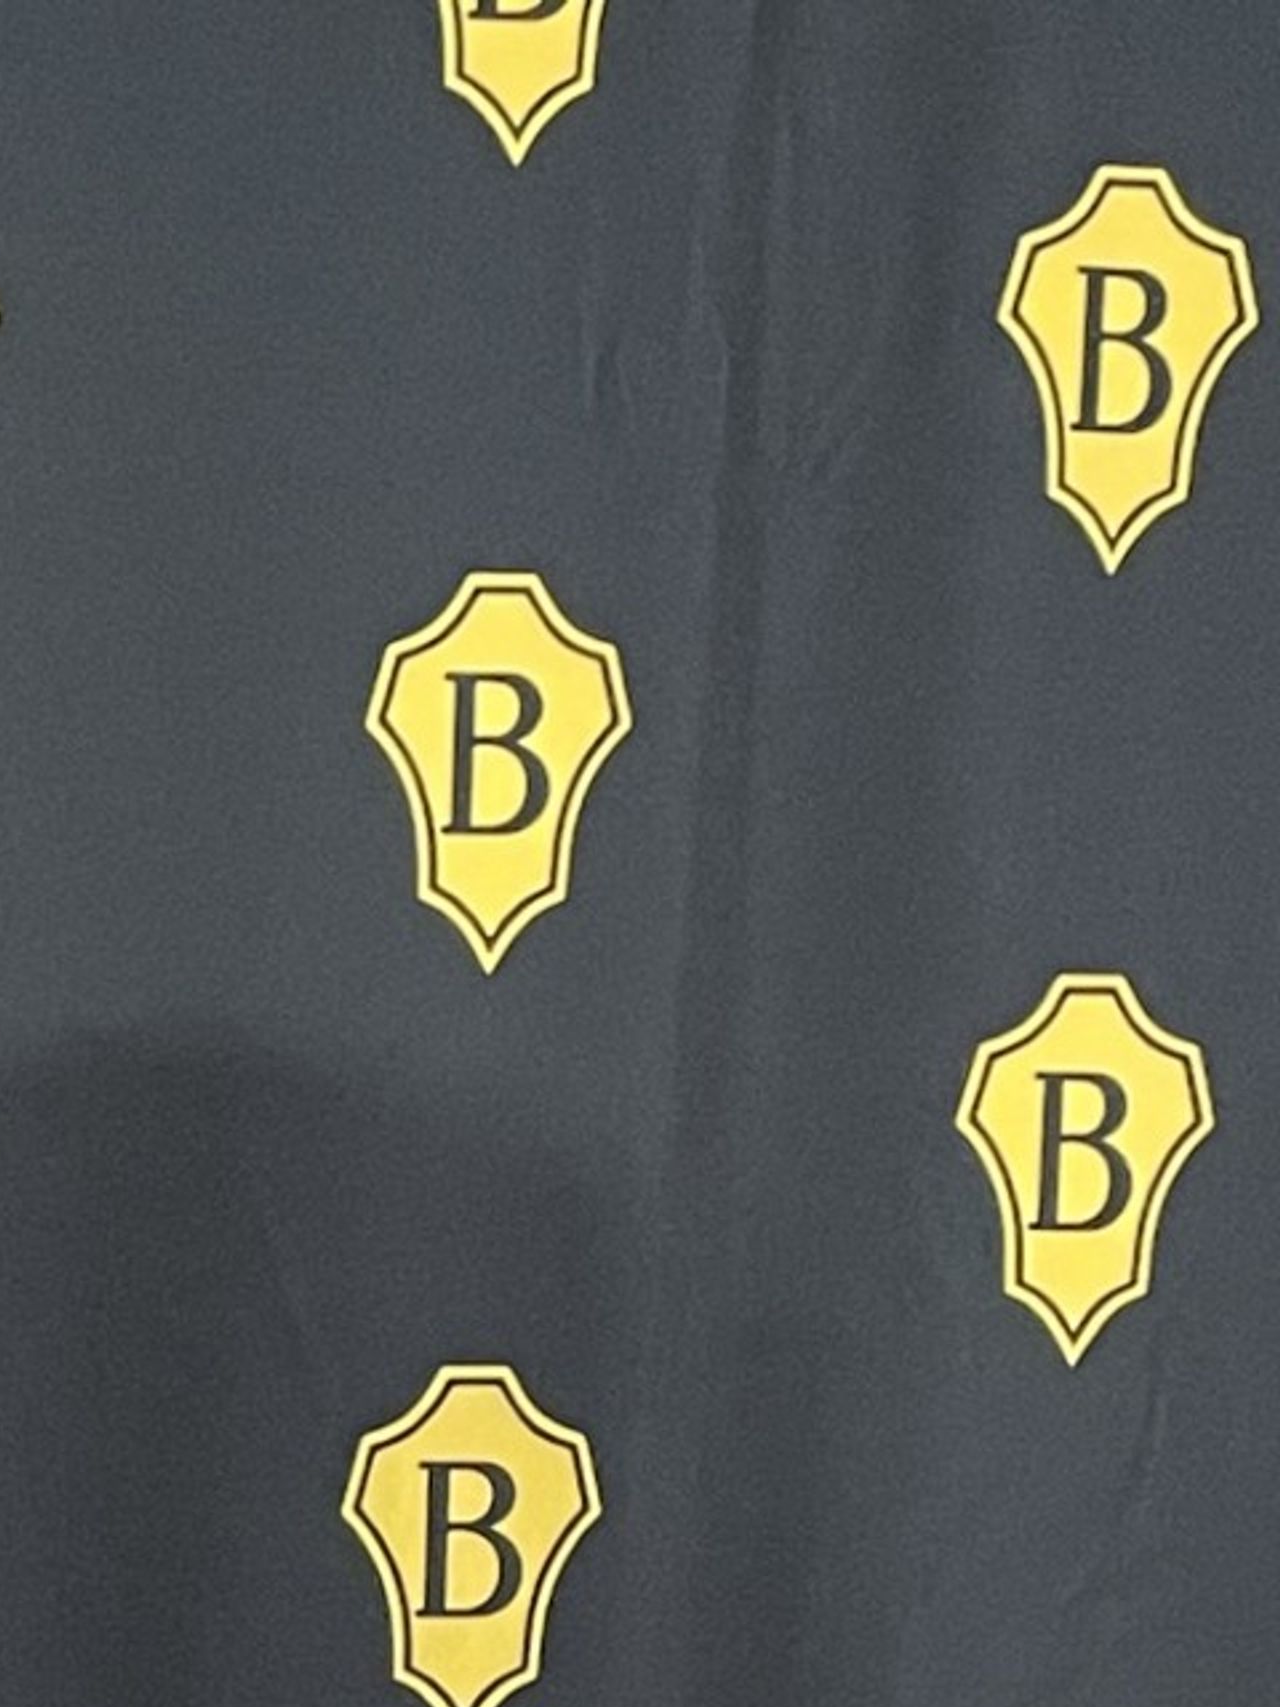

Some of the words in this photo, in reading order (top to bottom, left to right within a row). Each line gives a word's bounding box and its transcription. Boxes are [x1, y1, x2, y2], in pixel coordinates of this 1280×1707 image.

[1072, 268, 1170, 432] B
[442, 675, 547, 833] B
[1030, 1073, 1130, 1230] B
[417, 1463, 521, 1616] B
